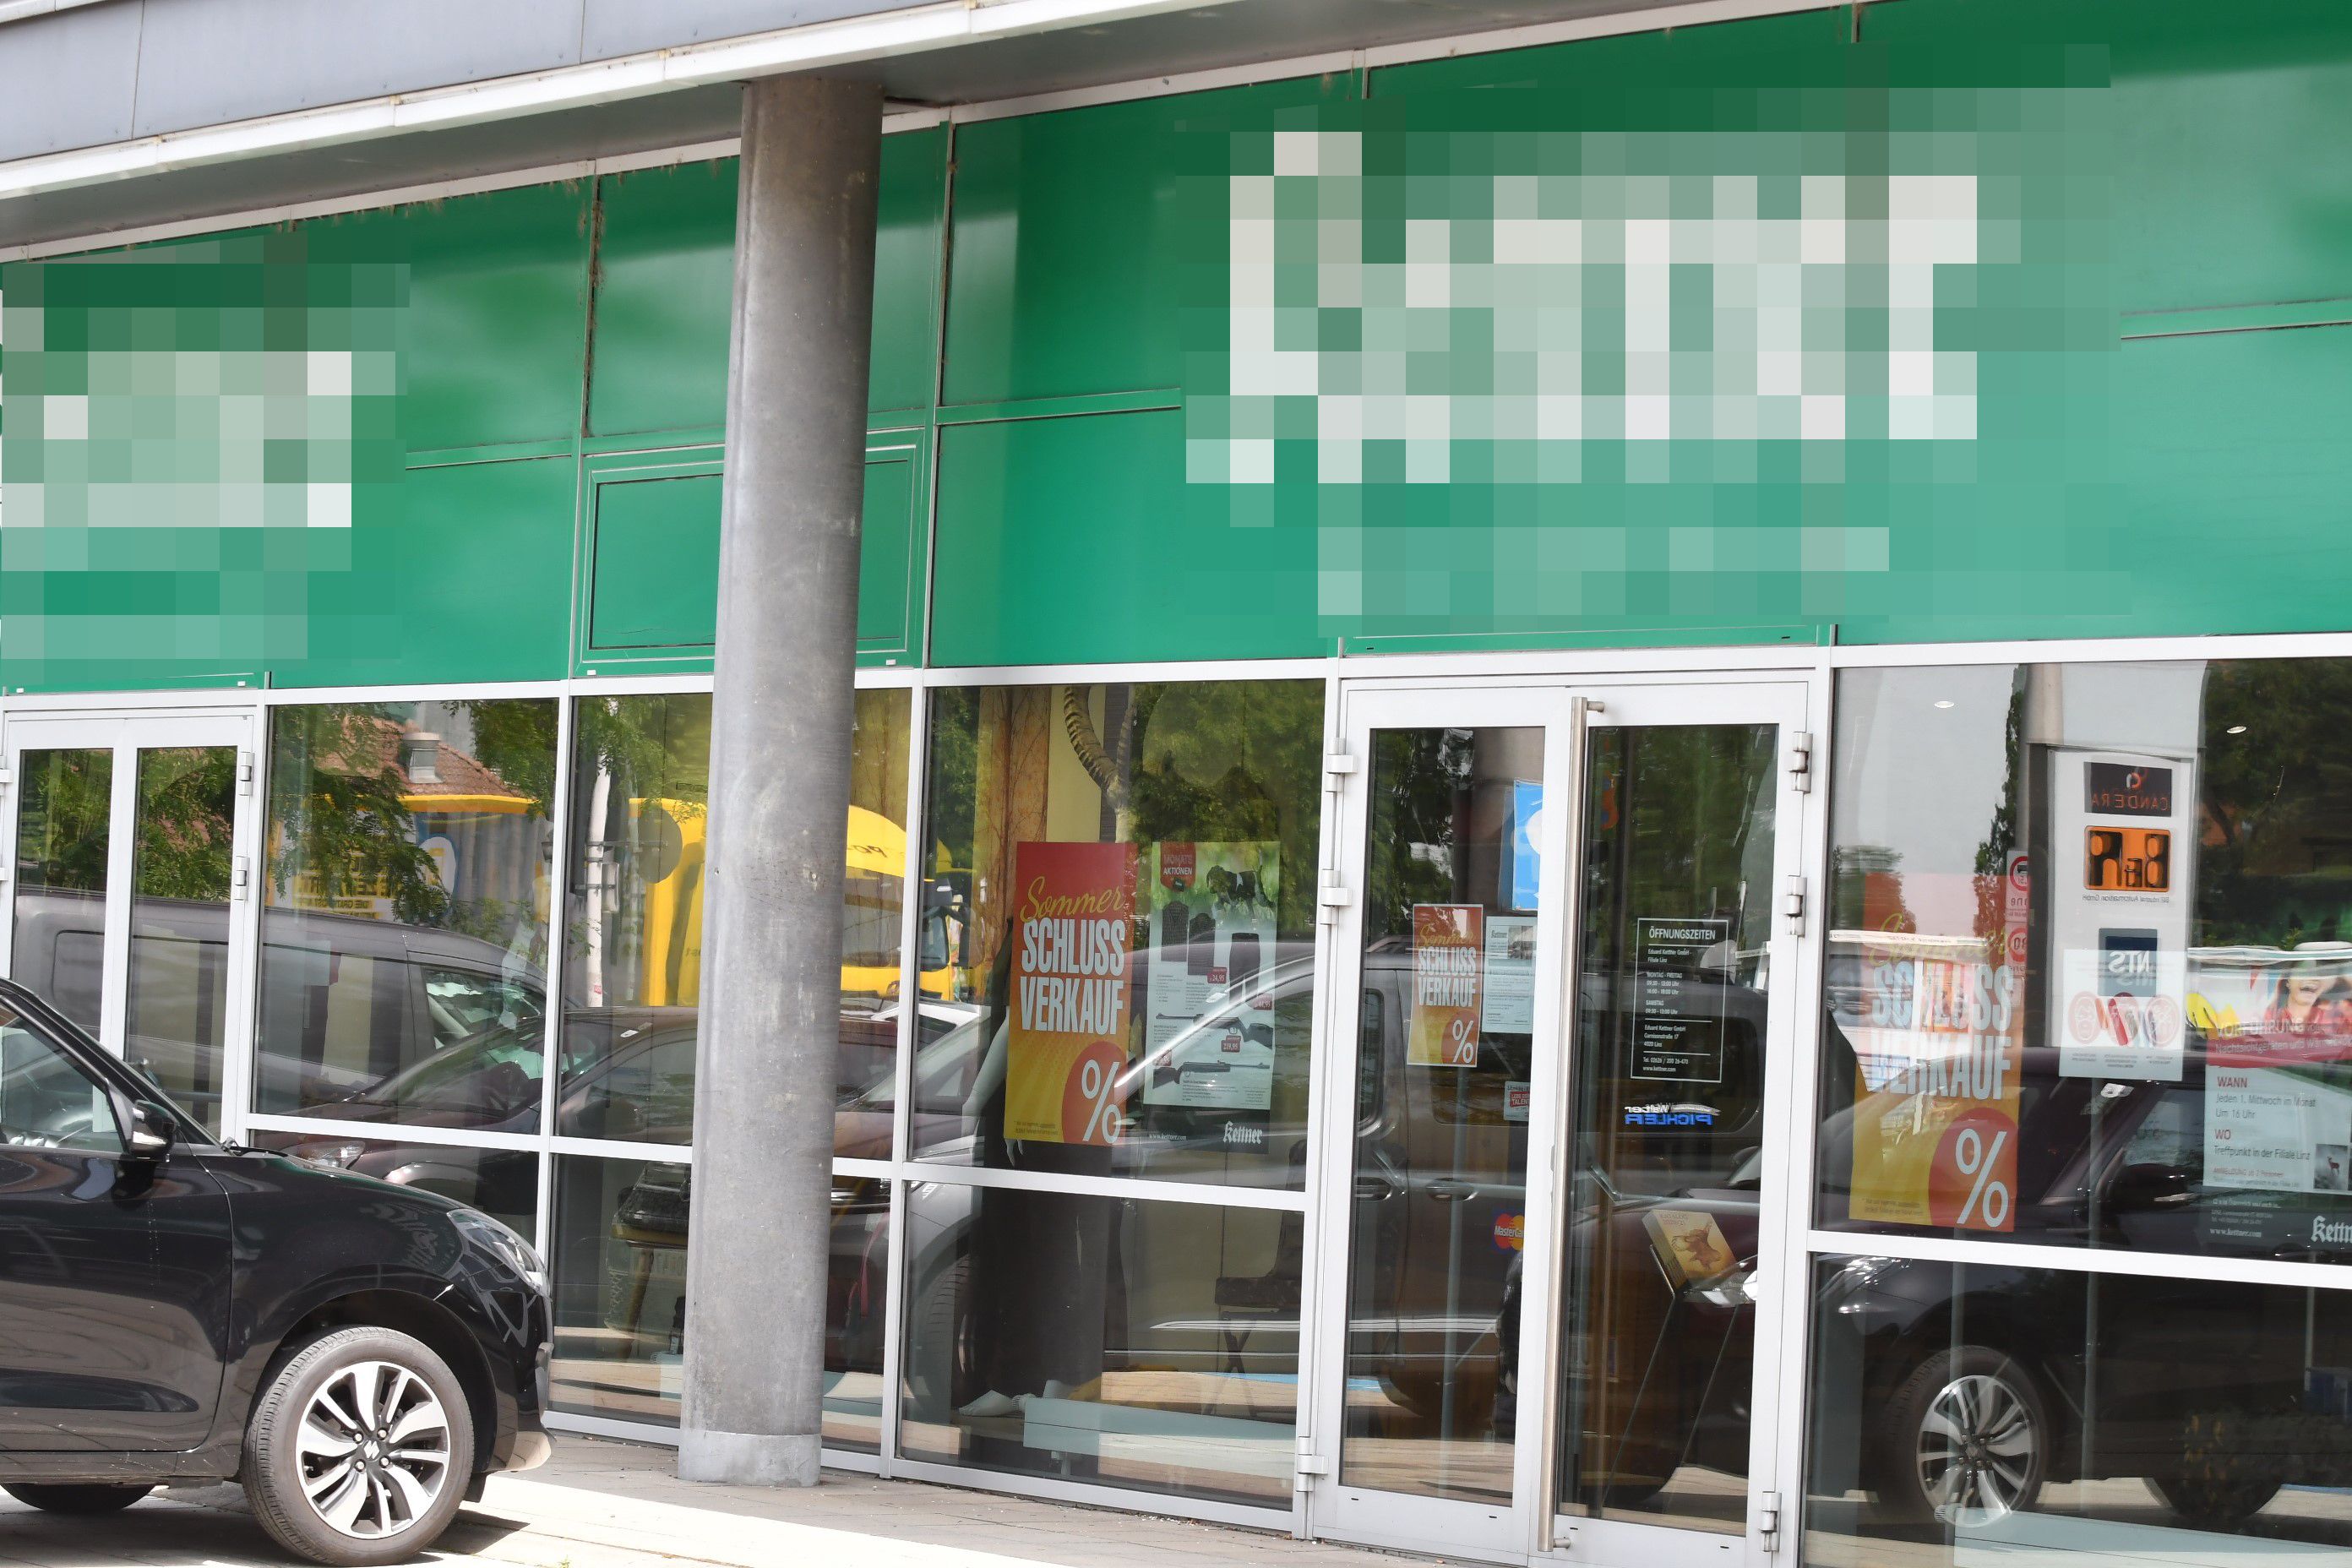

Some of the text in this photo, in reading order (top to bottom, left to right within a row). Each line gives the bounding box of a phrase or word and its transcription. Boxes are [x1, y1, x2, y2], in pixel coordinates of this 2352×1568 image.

[1163, 867, 1193, 875] AKTIONEN
[1020, 876, 1125, 922] Sommer
[1417, 923, 1475, 947] Sommer
[1648, 926, 1716, 940] ÖFFNUNGSZEITEN
[1021, 917, 1125, 977] SCHLUSS
[1418, 946, 1477, 977] SCHLUSS
[1418, 977, 1477, 1007] VERKAUF
[1020, 975, 1124, 1035] VERKAUF
[1870, 1030, 2012, 1100] VERKAUF
[2217, 1075, 2247, 1088] WANN
[2216, 1093, 2238, 1103] Jeden
[2249, 1094, 2281, 1106] Mittwoch
[2243, 1108, 2256, 1119] Uhr
[2214, 1129, 2231, 1140] WO
[2214, 1146, 2251, 1158] Treffpunkt
[2261, 1147, 2272, 1157] der
[2274, 1148, 2295, 1160] Filiale
[1494, 1225, 1525, 1239] MasterCa
[2311, 1215, 2352, 1243] Kettn
